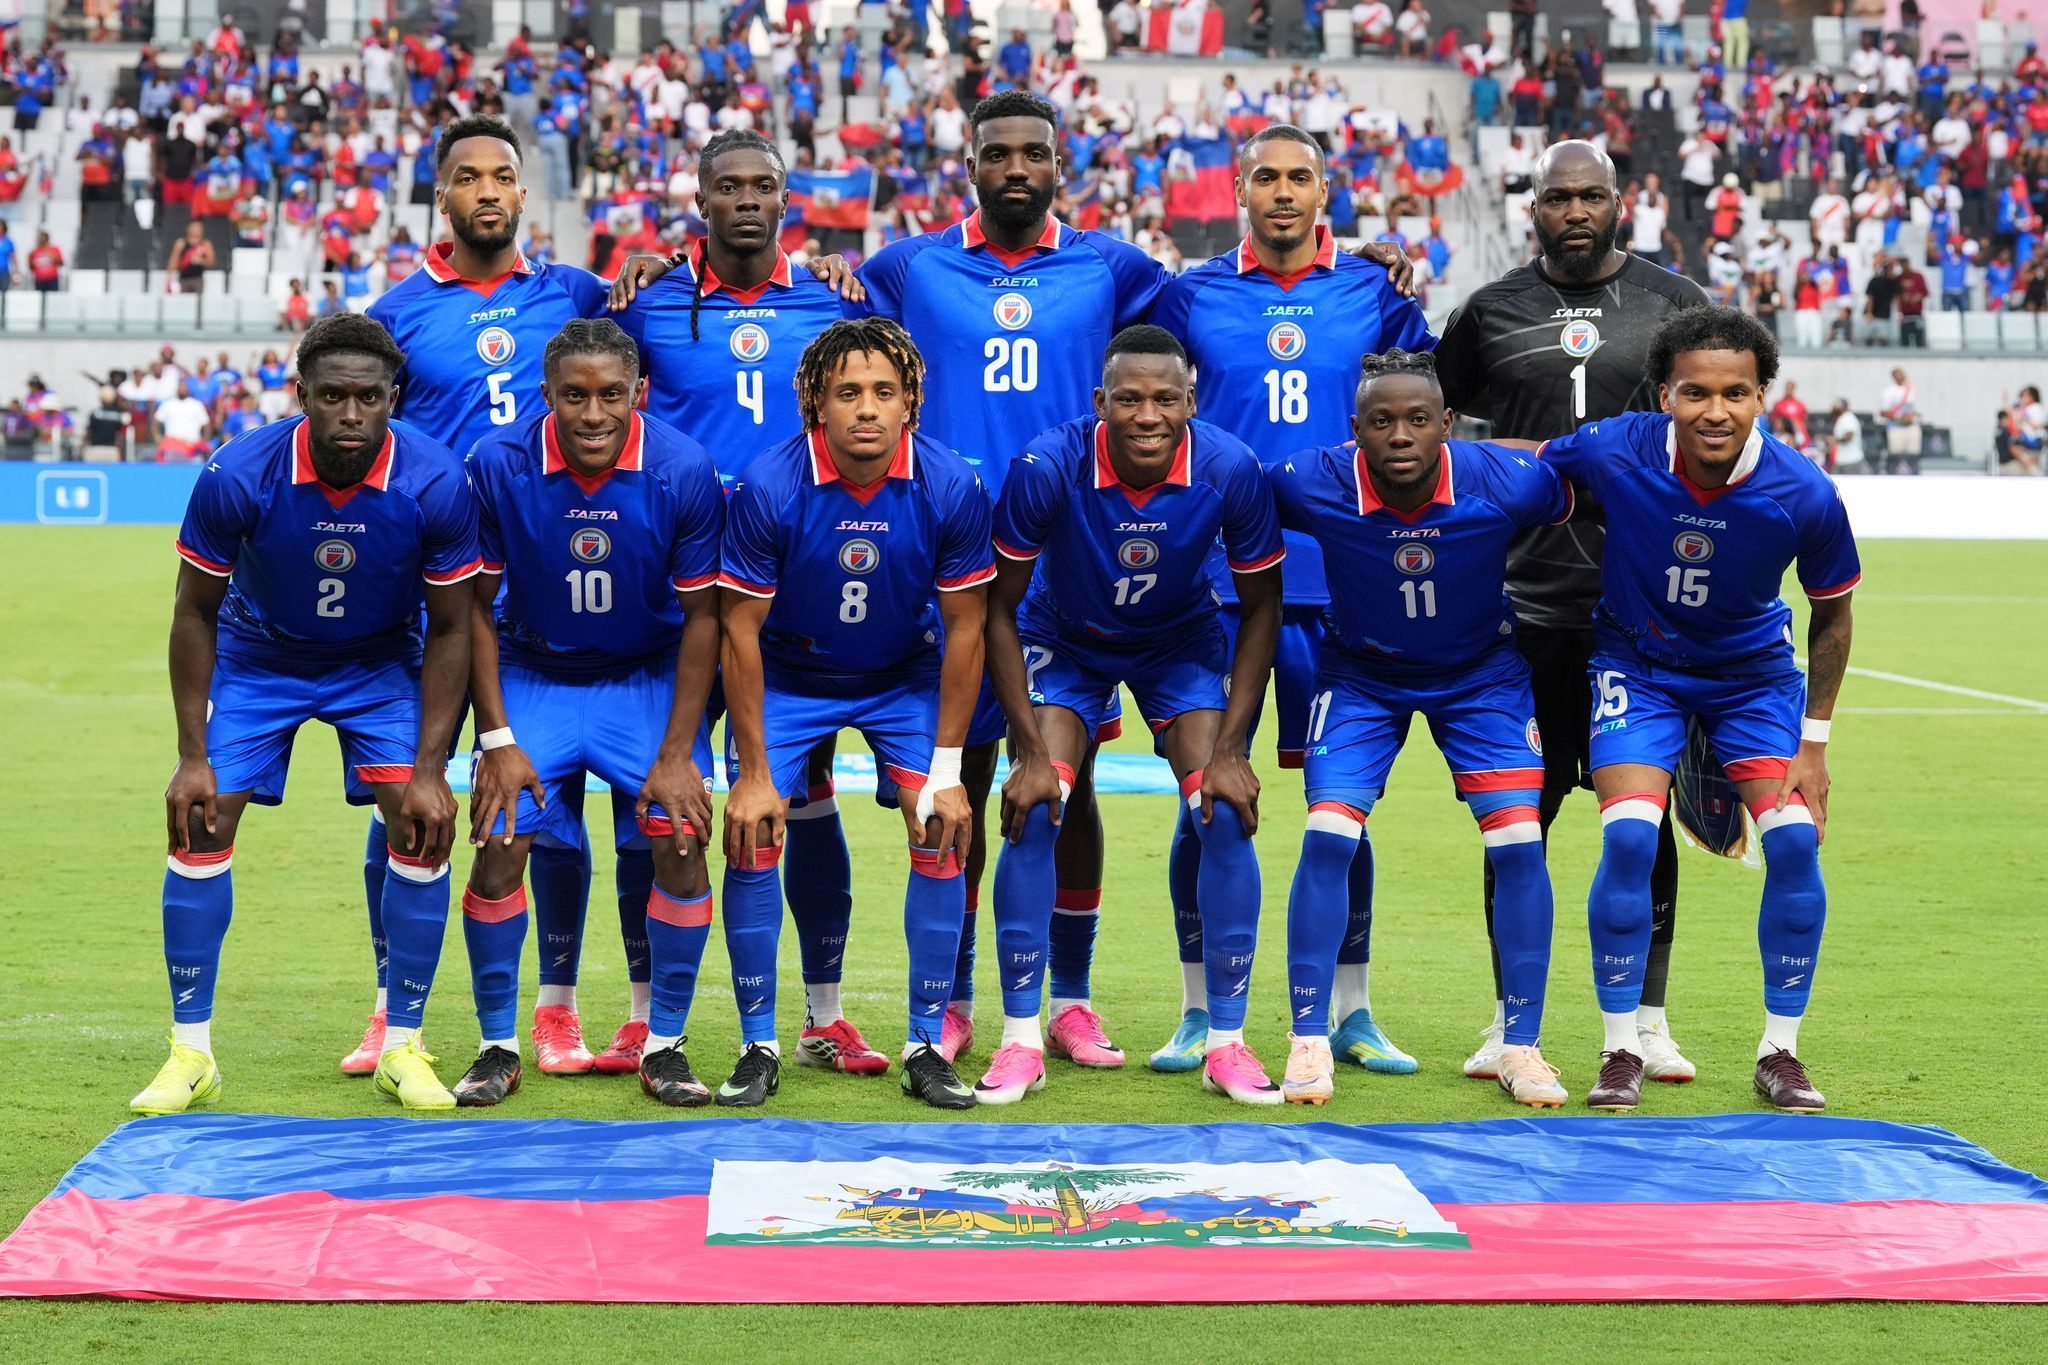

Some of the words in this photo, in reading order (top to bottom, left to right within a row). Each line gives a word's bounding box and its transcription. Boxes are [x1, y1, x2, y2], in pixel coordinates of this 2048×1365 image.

[987, 277, 1039, 288] SAETA
[466, 306, 517, 325] SAETA
[723, 307, 777, 319] SAETA
[1262, 305, 1314, 316] SAETA
[1550, 307, 1603, 319] SAETA
[983, 337, 1038, 392] 20
[736, 370, 764, 425] 4
[1263, 369, 1308, 424] 18
[1569, 364, 1586, 419] 1
[486, 371, 516, 426] 5
[563, 509, 619, 521] SAETA
[310, 521, 367, 533] SAETA
[834, 520, 890, 532] SAETA
[1113, 521, 1168, 533] SAETA
[1672, 513, 1727, 531] SAETA
[1386, 527, 1441, 540] SAETA
[565, 569, 613, 614] 10
[1113, 573, 1158, 606] 17
[1664, 565, 1712, 608] 15
[316, 578, 346, 618] 2
[839, 580, 868, 624] 8
[1399, 580, 1437, 619] 11
[1595, 670, 1629, 722] 15
[1306, 690, 1333, 744] 11
[548, 933, 574, 944] FHF
[625, 938, 650, 949] FHF
[821, 936, 845, 946] FHF
[1013, 951, 1040, 964] FHF
[1231, 951, 1254, 967] FHF
[1604, 954, 1635, 966] FHF
[1781, 955, 1811, 967] FHF
[172, 965, 201, 978] FHF
[404, 978, 428, 993] FHF
[738, 976, 764, 988] FHF
[924, 980, 950, 991] FHF
[1294, 986, 1317, 998] FHF
[1507, 995, 1529, 1007] FHF
